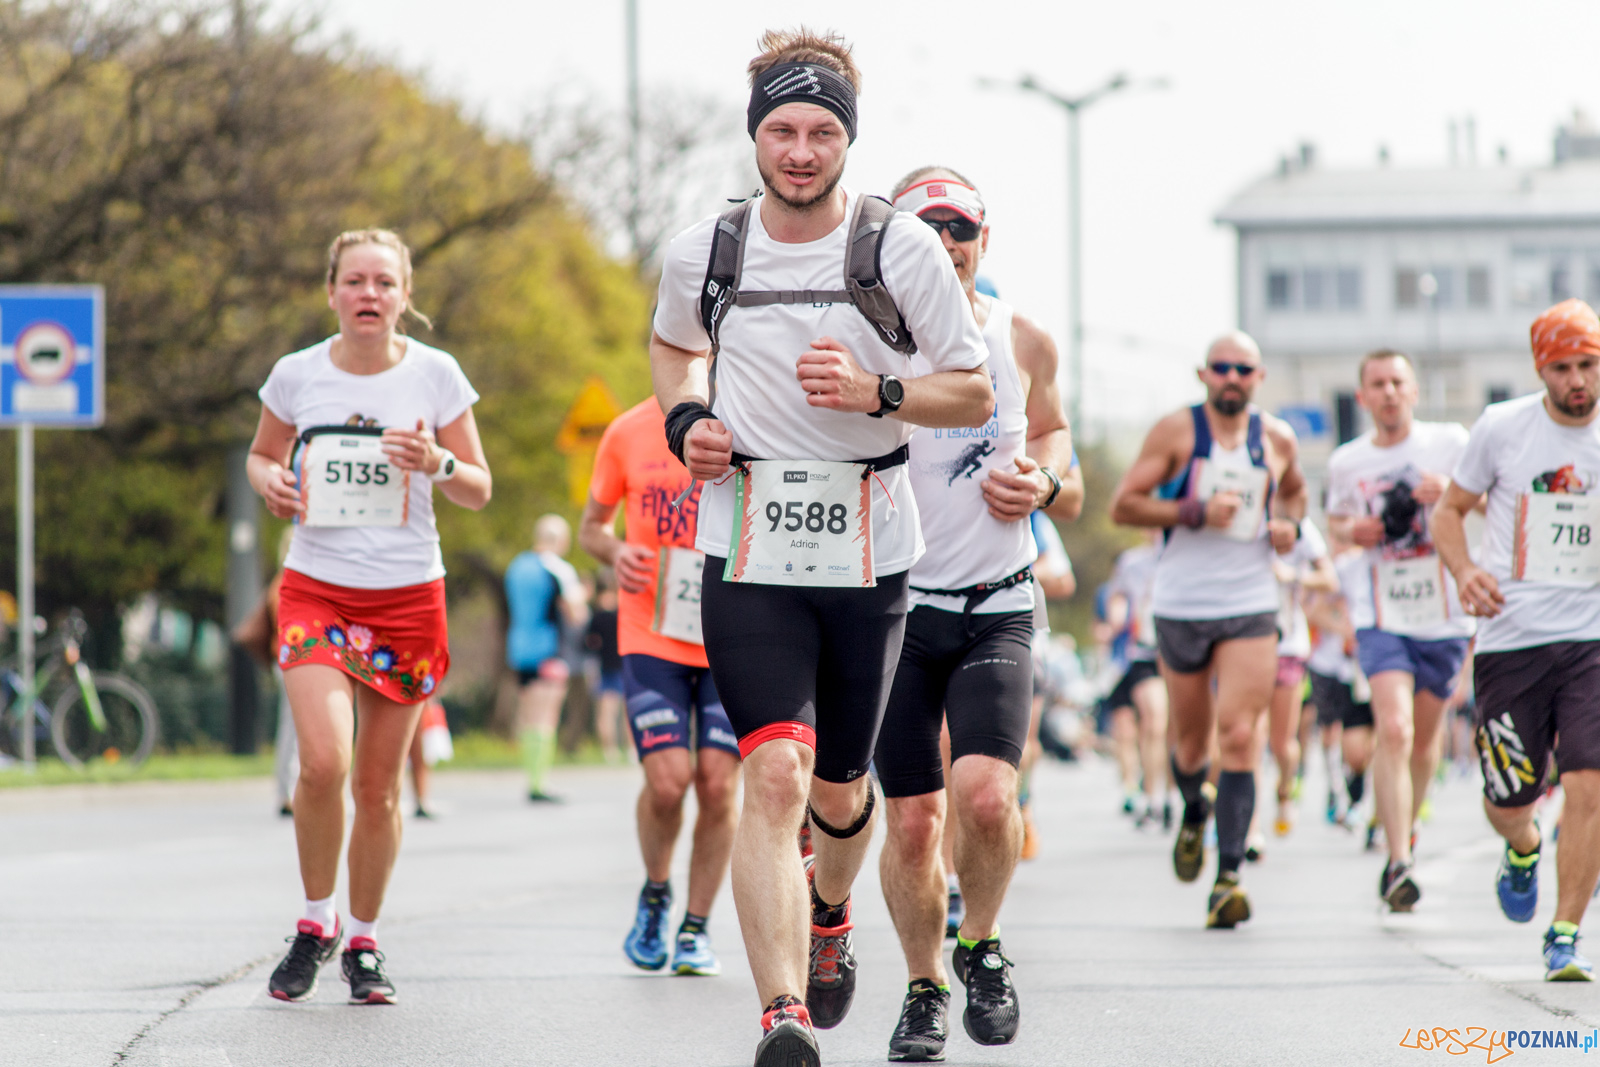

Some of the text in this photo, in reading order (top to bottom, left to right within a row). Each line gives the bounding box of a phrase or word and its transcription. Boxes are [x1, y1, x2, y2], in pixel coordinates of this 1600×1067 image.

[935, 421, 999, 438] TEAM
[325, 460, 389, 485] 5135
[765, 501, 848, 535] 9588
[790, 539, 820, 550] Adrian
[1551, 522, 1591, 546] 718
